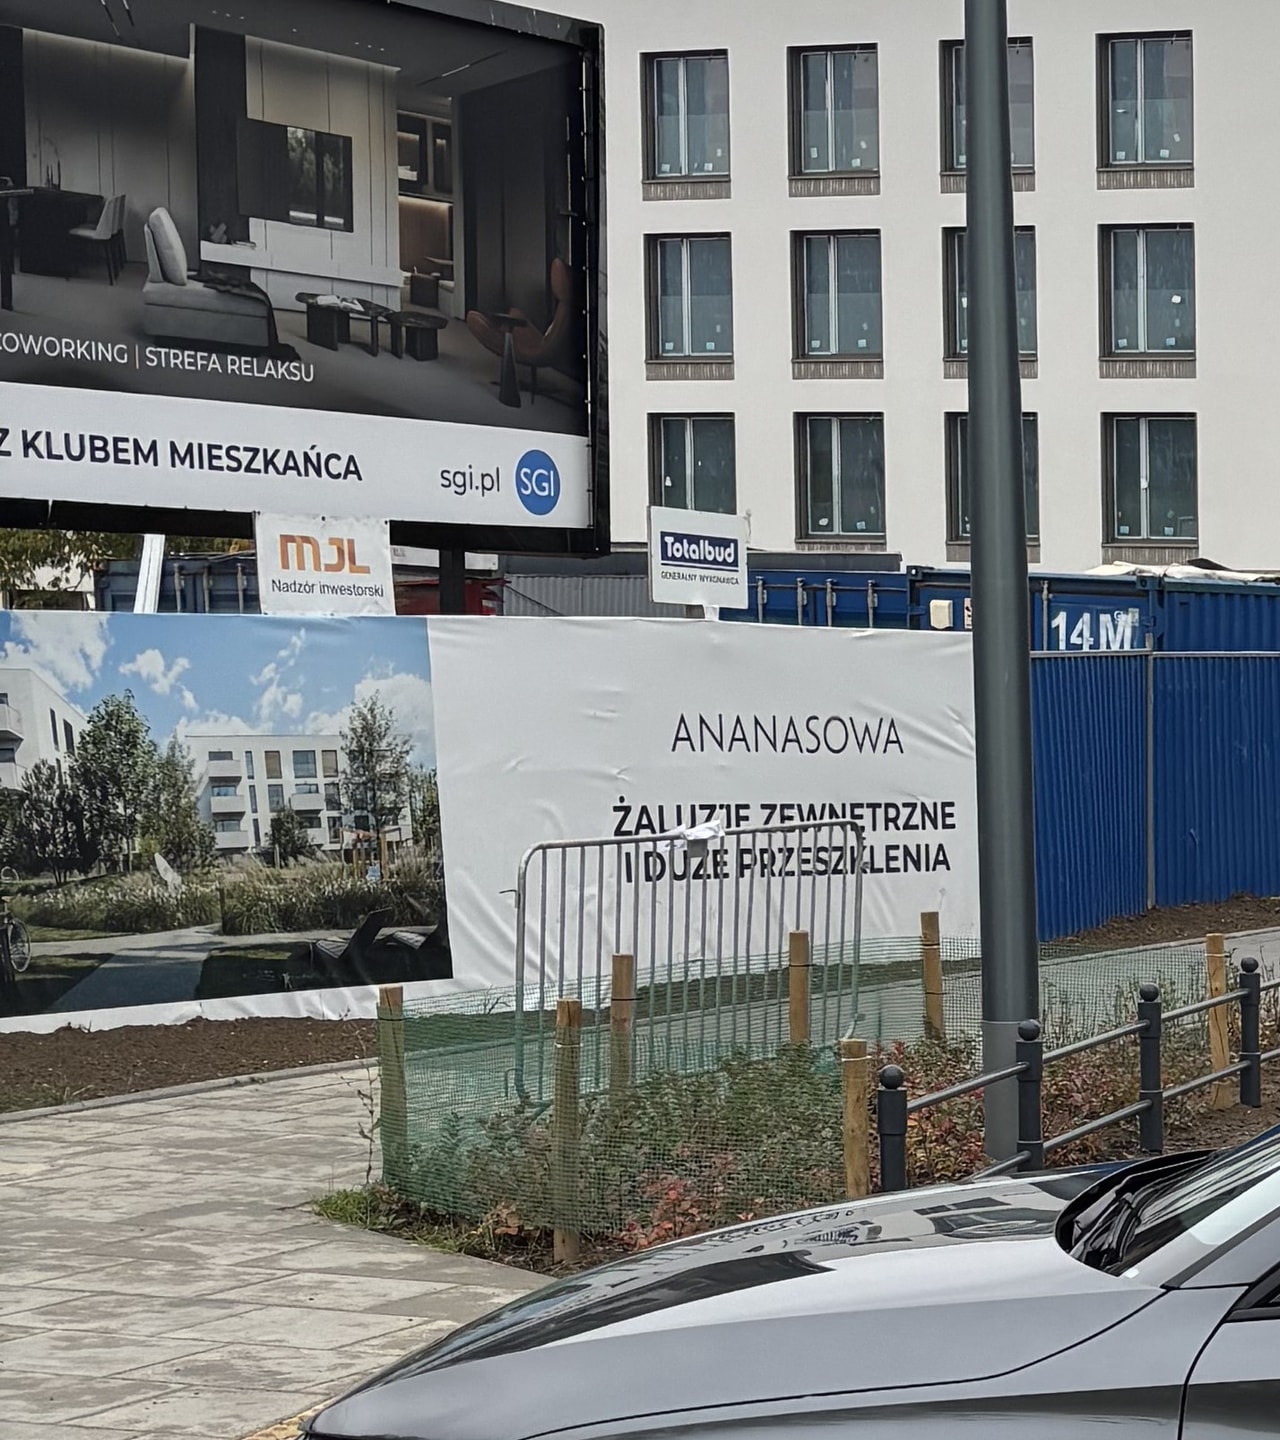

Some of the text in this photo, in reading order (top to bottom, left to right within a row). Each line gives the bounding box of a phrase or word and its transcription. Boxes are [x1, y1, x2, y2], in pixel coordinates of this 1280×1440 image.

[0, 332, 129, 364] OWORKING
[145, 346, 223, 373] STREFA
[227, 355, 315, 382] RELAKSU
[21, 429, 159, 467] KLUBEM
[169, 440, 363, 481] MIESZKAŃCA
[440, 464, 500, 497] sgi.pl
[520, 467, 555, 497] SGI
[278, 534, 371, 575] MJL
[664, 536, 735, 563] Totalbud
[271, 579, 384, 598] Nadzór inwestorski
[671, 713, 904, 755] ANANASOWA
[624, 852, 633, 883] I
